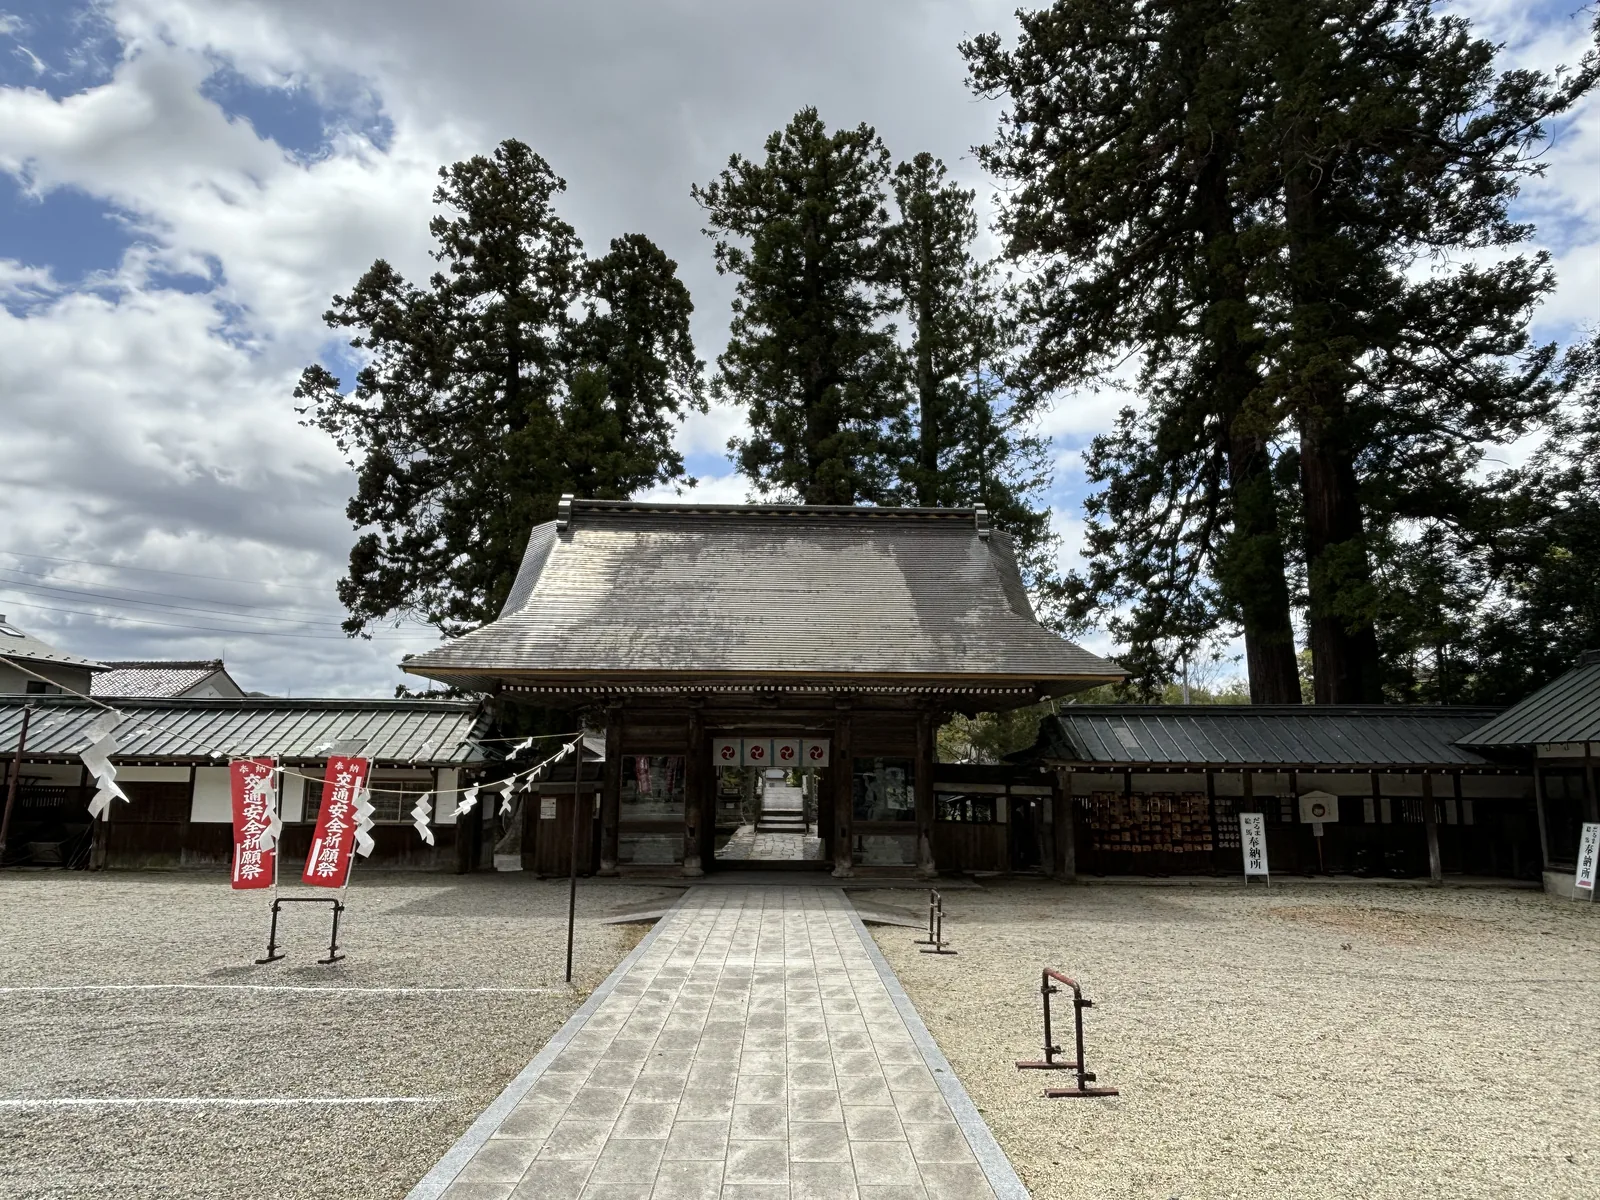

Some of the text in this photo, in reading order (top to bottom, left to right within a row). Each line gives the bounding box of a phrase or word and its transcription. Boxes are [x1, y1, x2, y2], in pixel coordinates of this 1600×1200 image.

[239, 765, 266, 774] 奉納
[335, 761, 360, 773] 奉納
[240, 773, 267, 880] 交通安全祈願祭
[317, 772, 352, 877] 交通安全祈願祭
[1253, 817, 1261, 836] だるま
[1248, 837, 1261, 869] 奉納所
[1581, 844, 1593, 879] 奉納所
